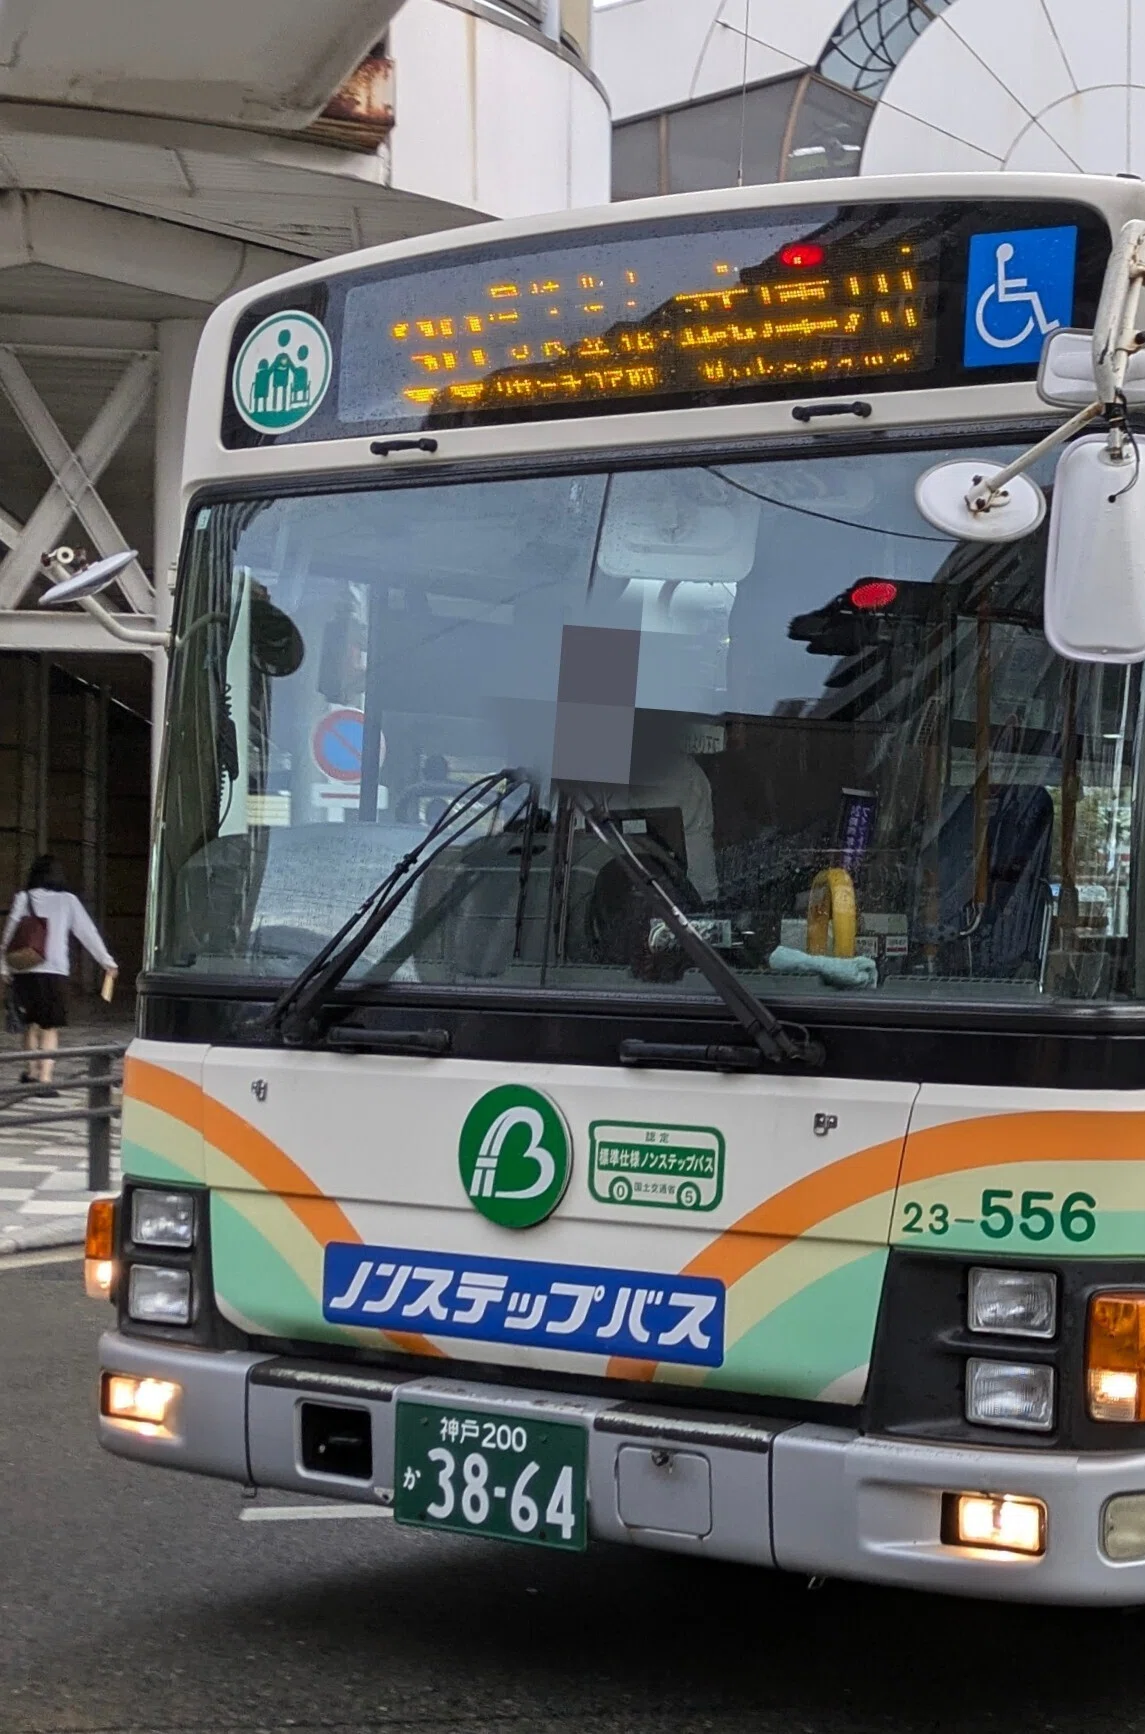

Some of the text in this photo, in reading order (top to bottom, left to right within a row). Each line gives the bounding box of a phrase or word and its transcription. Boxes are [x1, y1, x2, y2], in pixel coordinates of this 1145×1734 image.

[644, 1131, 670, 1143] 認定
[599, 1147, 714, 1173] 標準仕様ノンステップバス
[633, 1182, 676, 1195] 国土交通省
[684, 1190, 693, 1204] 5
[902, 1189, 1096, 1243] 23-556
[329, 1261, 718, 1350] ノンステップバス
[440, 1416, 528, 1453] 神戸200
[402, 1447, 576, 1540] か 38-64
